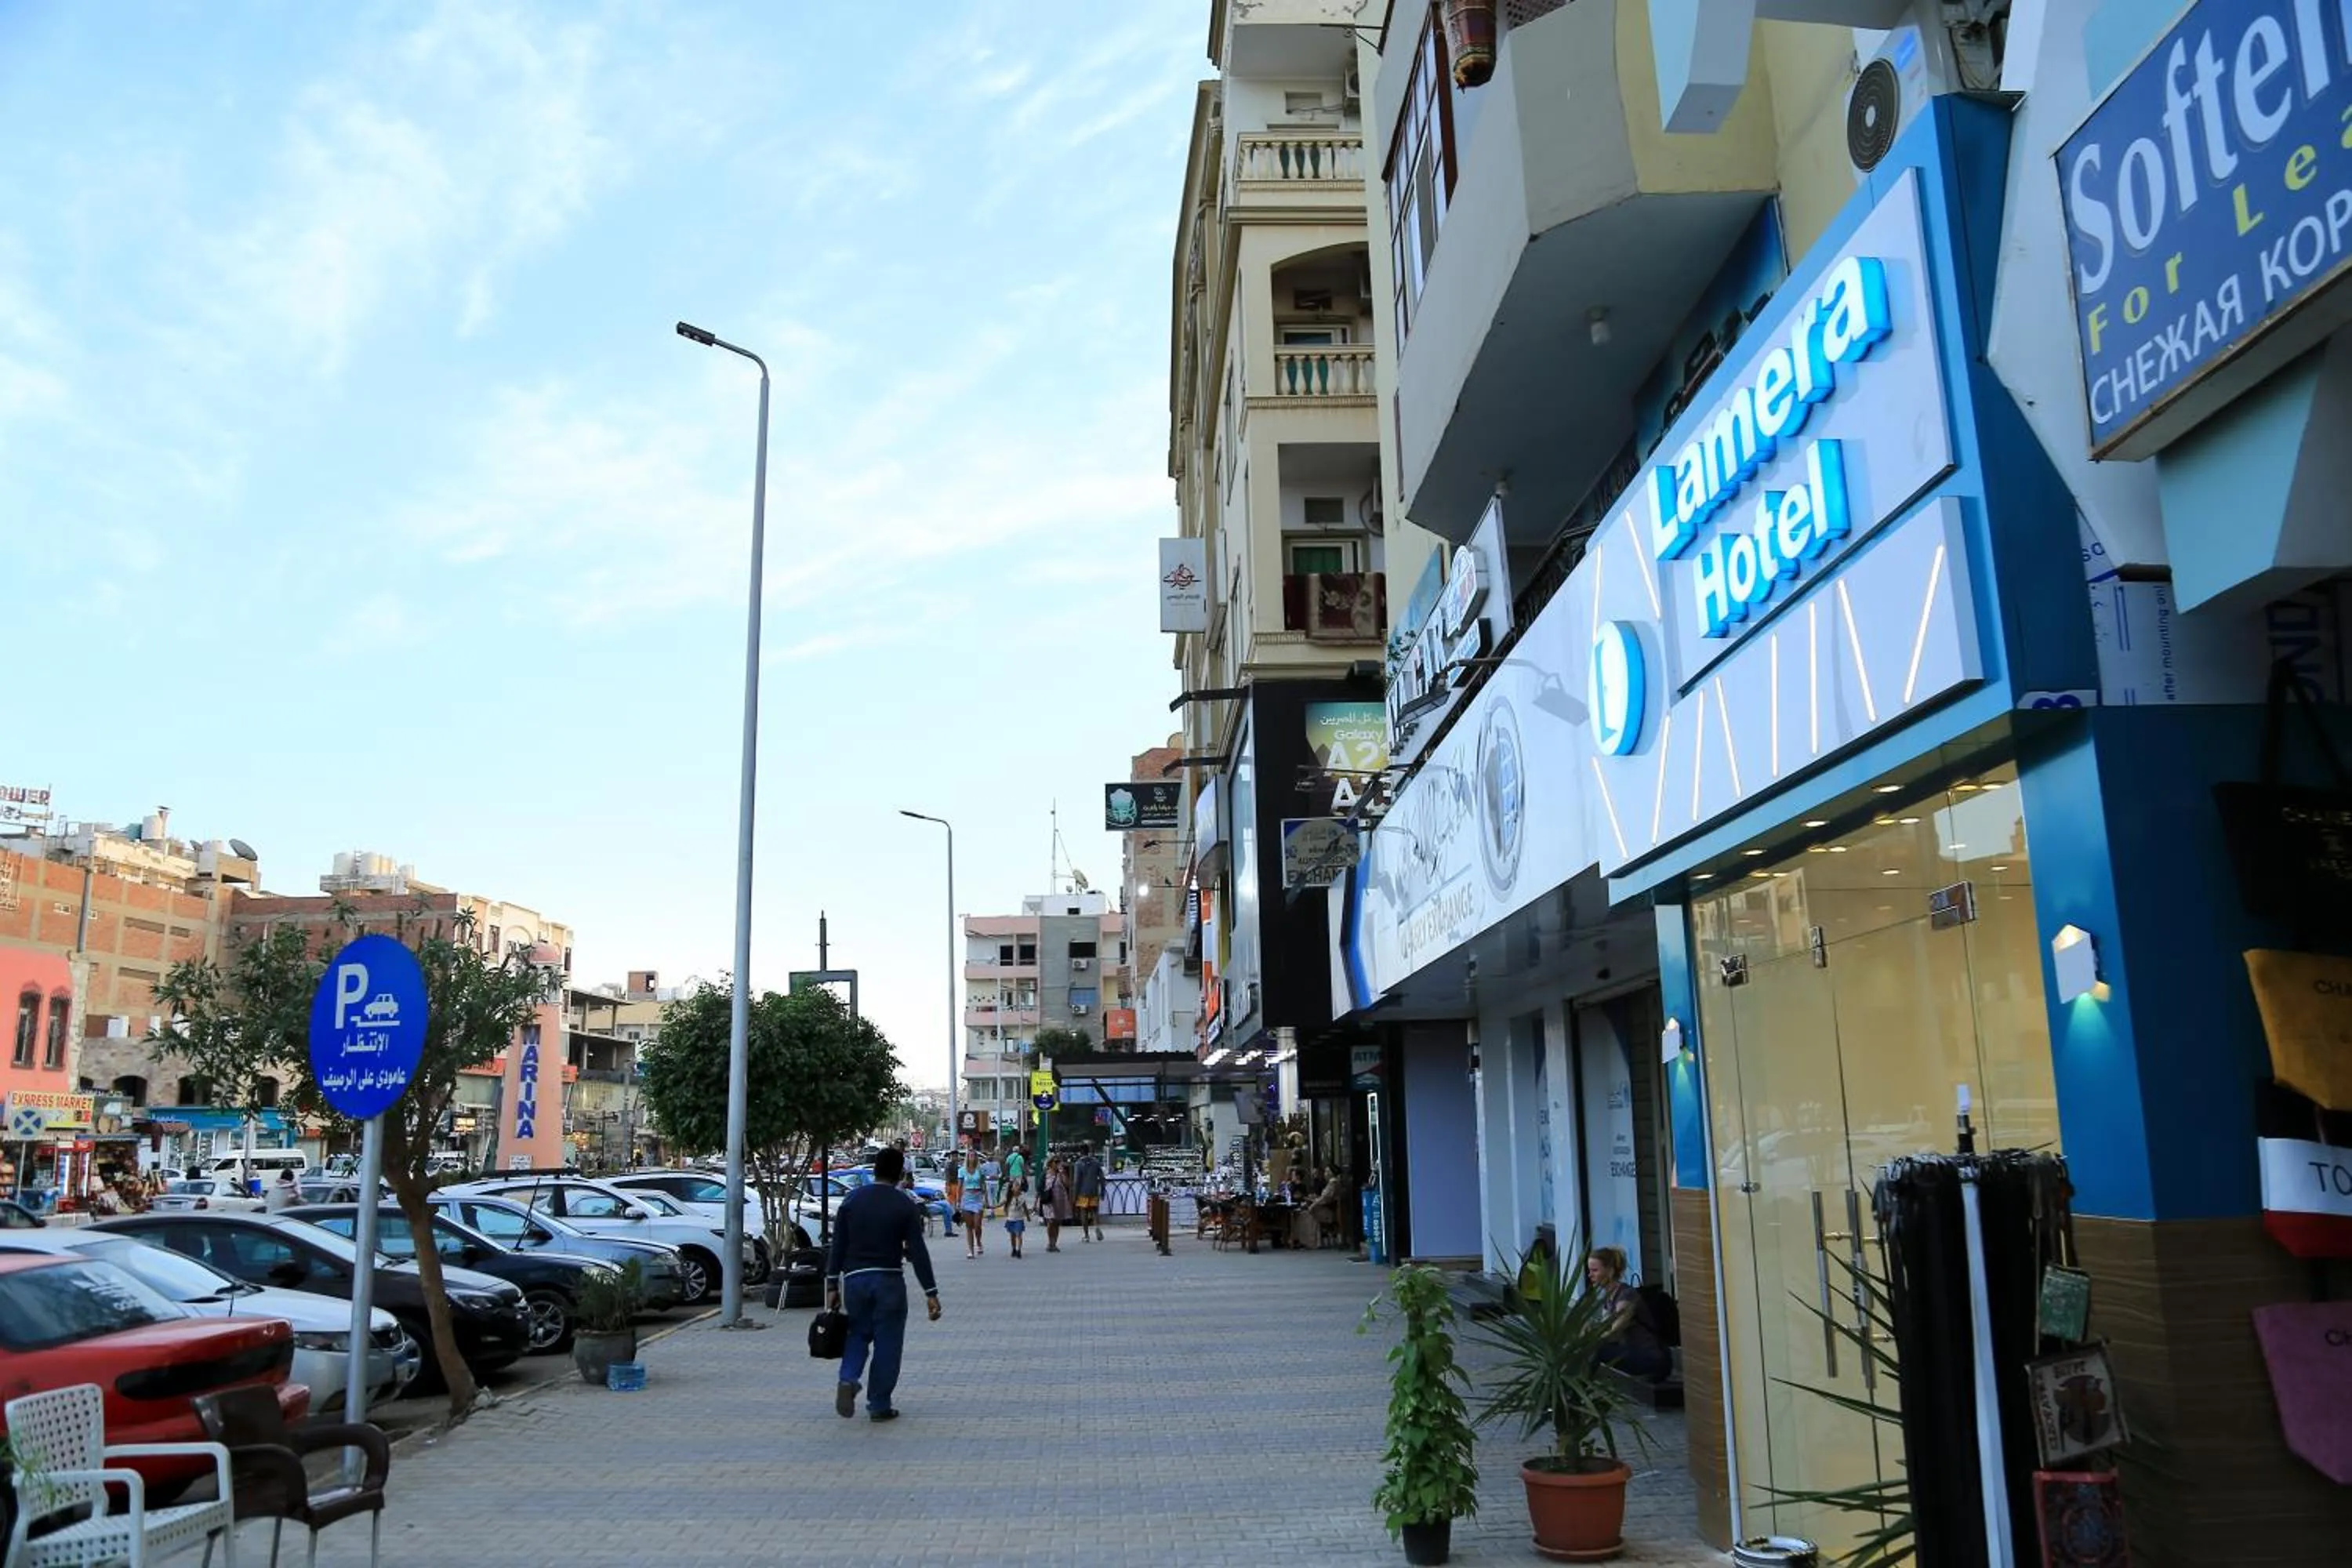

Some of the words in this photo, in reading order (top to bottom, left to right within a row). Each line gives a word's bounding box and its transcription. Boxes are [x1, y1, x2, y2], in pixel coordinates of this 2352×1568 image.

[2087, 251, 2183, 356] For
[2089, 273, 2244, 425] СНЕЖАЯ
[1647, 256, 1886, 560] Lamera
[1693, 439, 1847, 638] Hotel
[2158, 608, 2172, 669] mounting
[1334, 729, 1384, 744] Galaxy
[335, 963, 369, 1029] P
[322, 1067, 357, 1091] الرصيف
[517, 1024, 542, 1138] MARINA
[1353, 1051, 1381, 1063] ATM
[56, 1094, 93, 1109] MARKET
